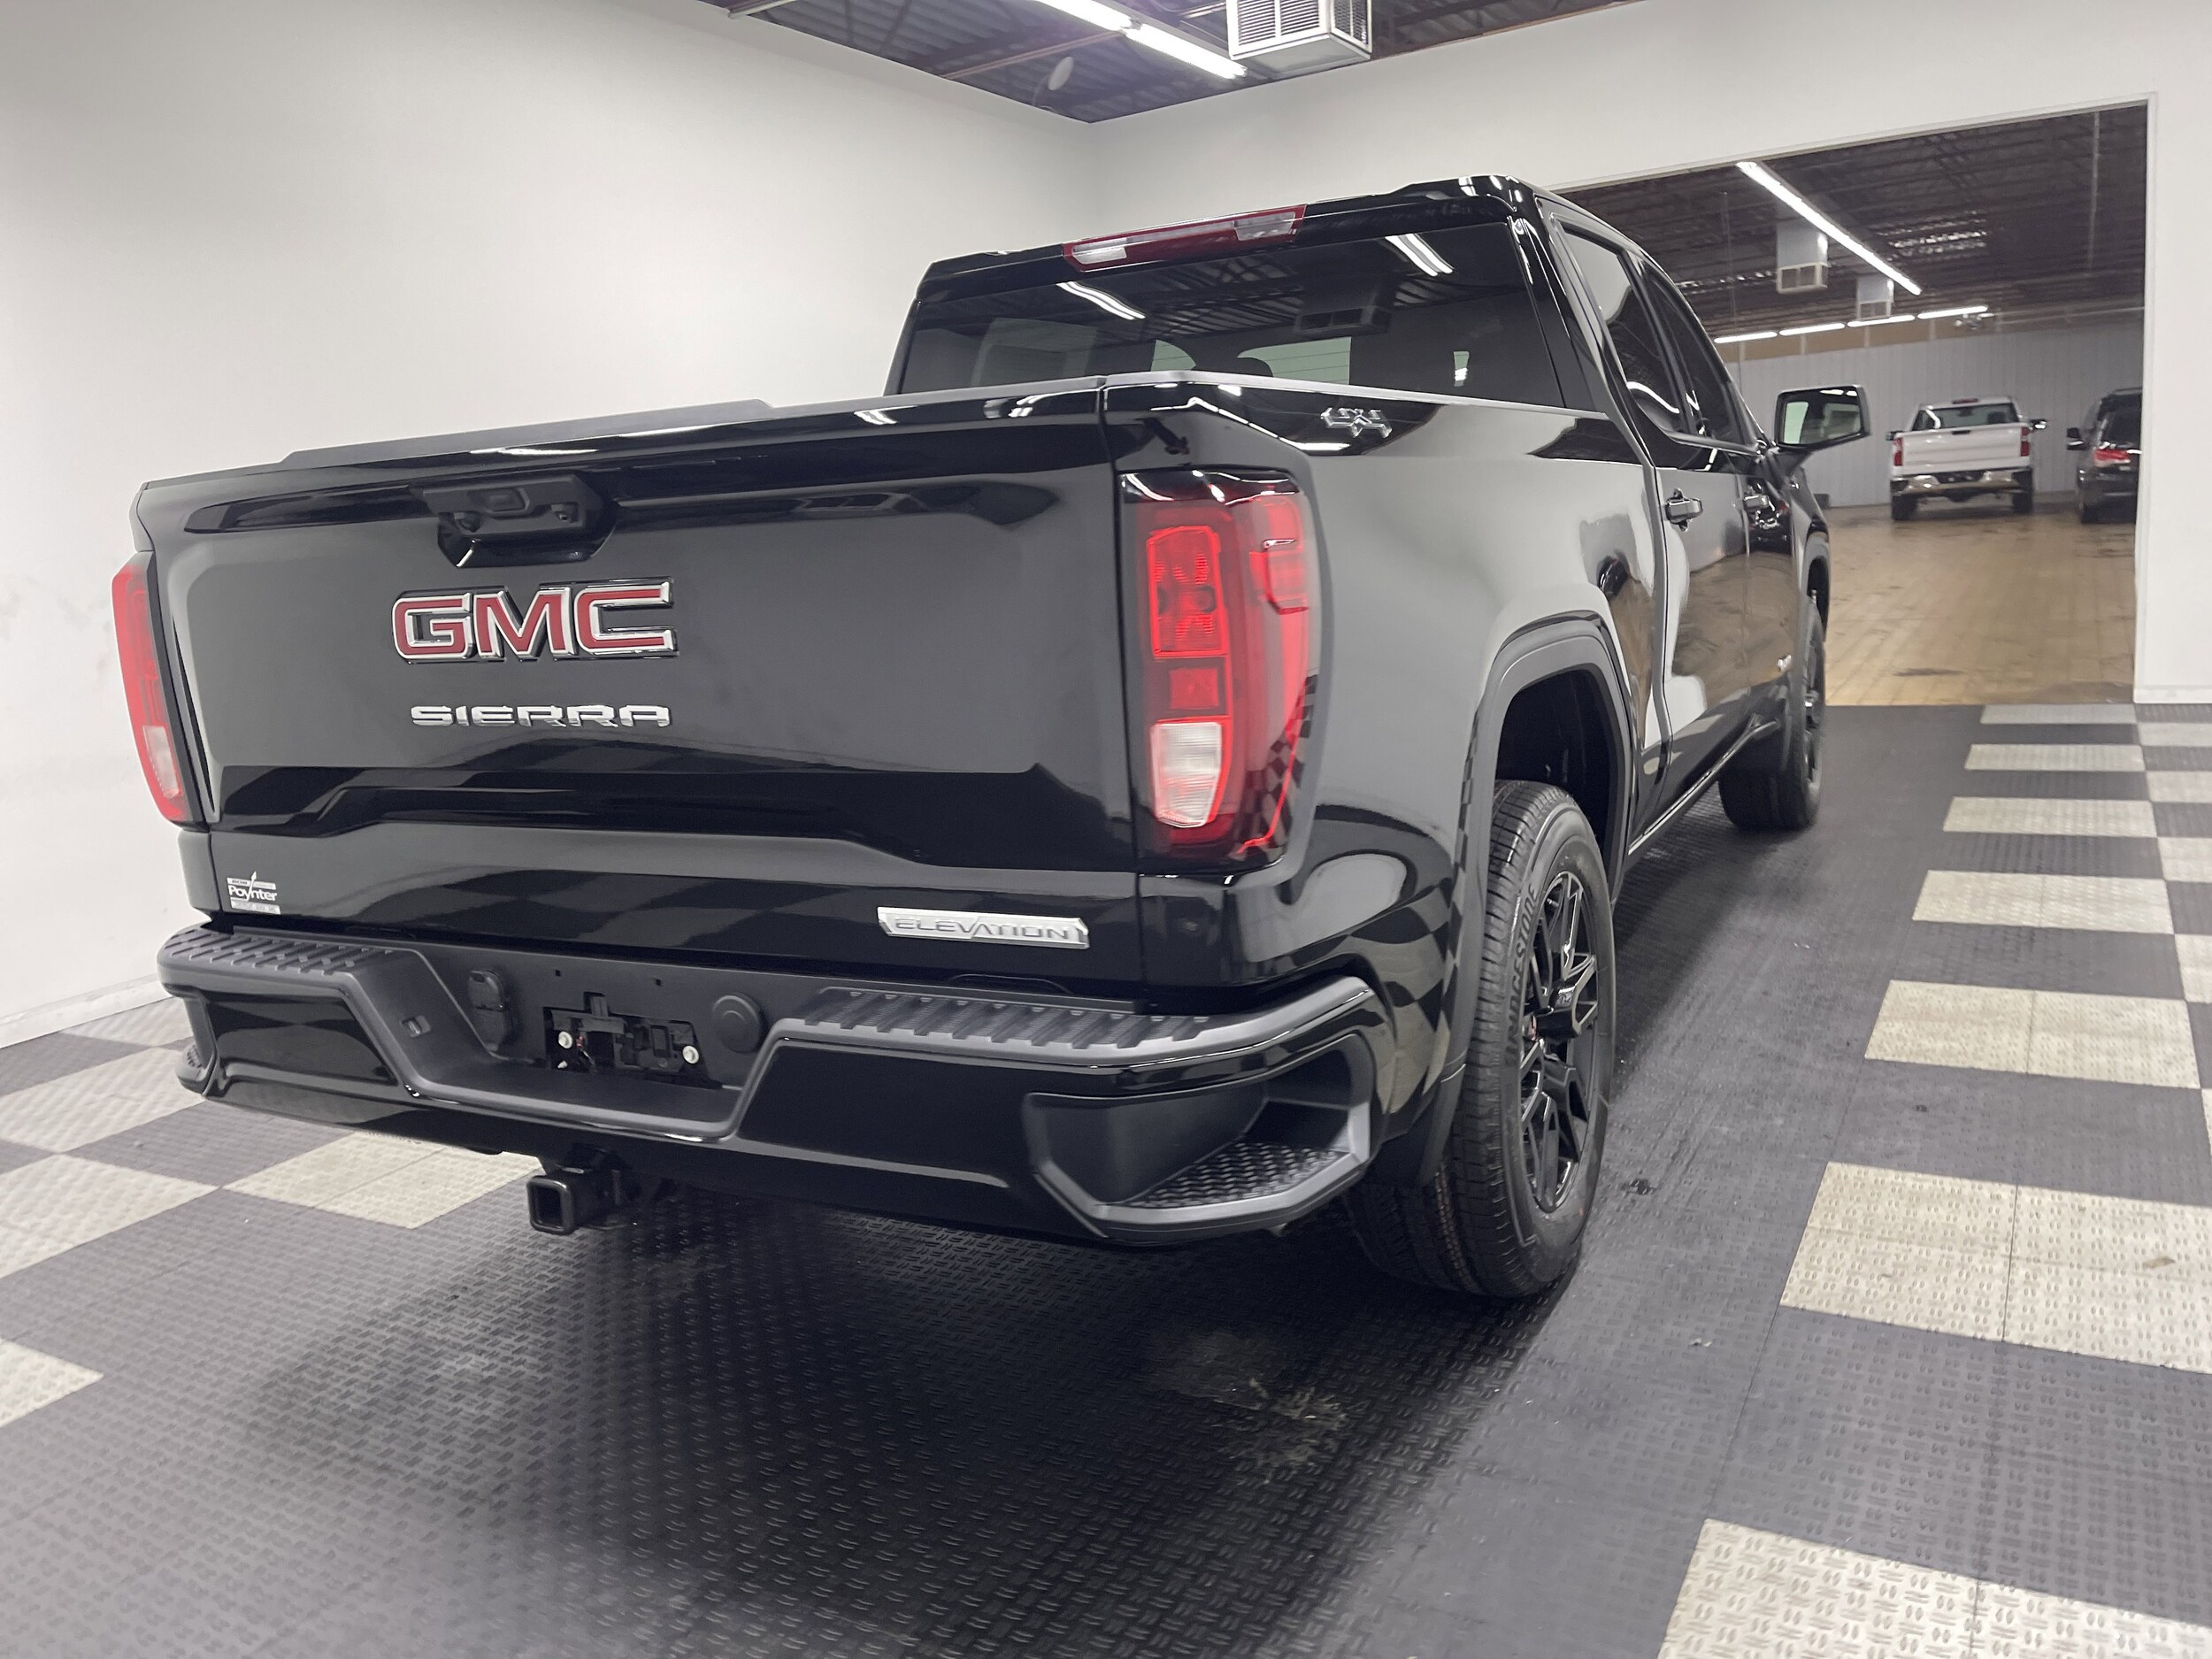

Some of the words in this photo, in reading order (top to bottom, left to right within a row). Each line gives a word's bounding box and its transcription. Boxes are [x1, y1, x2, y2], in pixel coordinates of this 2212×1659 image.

[392, 576, 679, 664] GMC
[411, 705, 672, 727] SIERRA
[228, 885, 277, 901] Poynter
[895, 918, 1069, 940] ELEVATION
